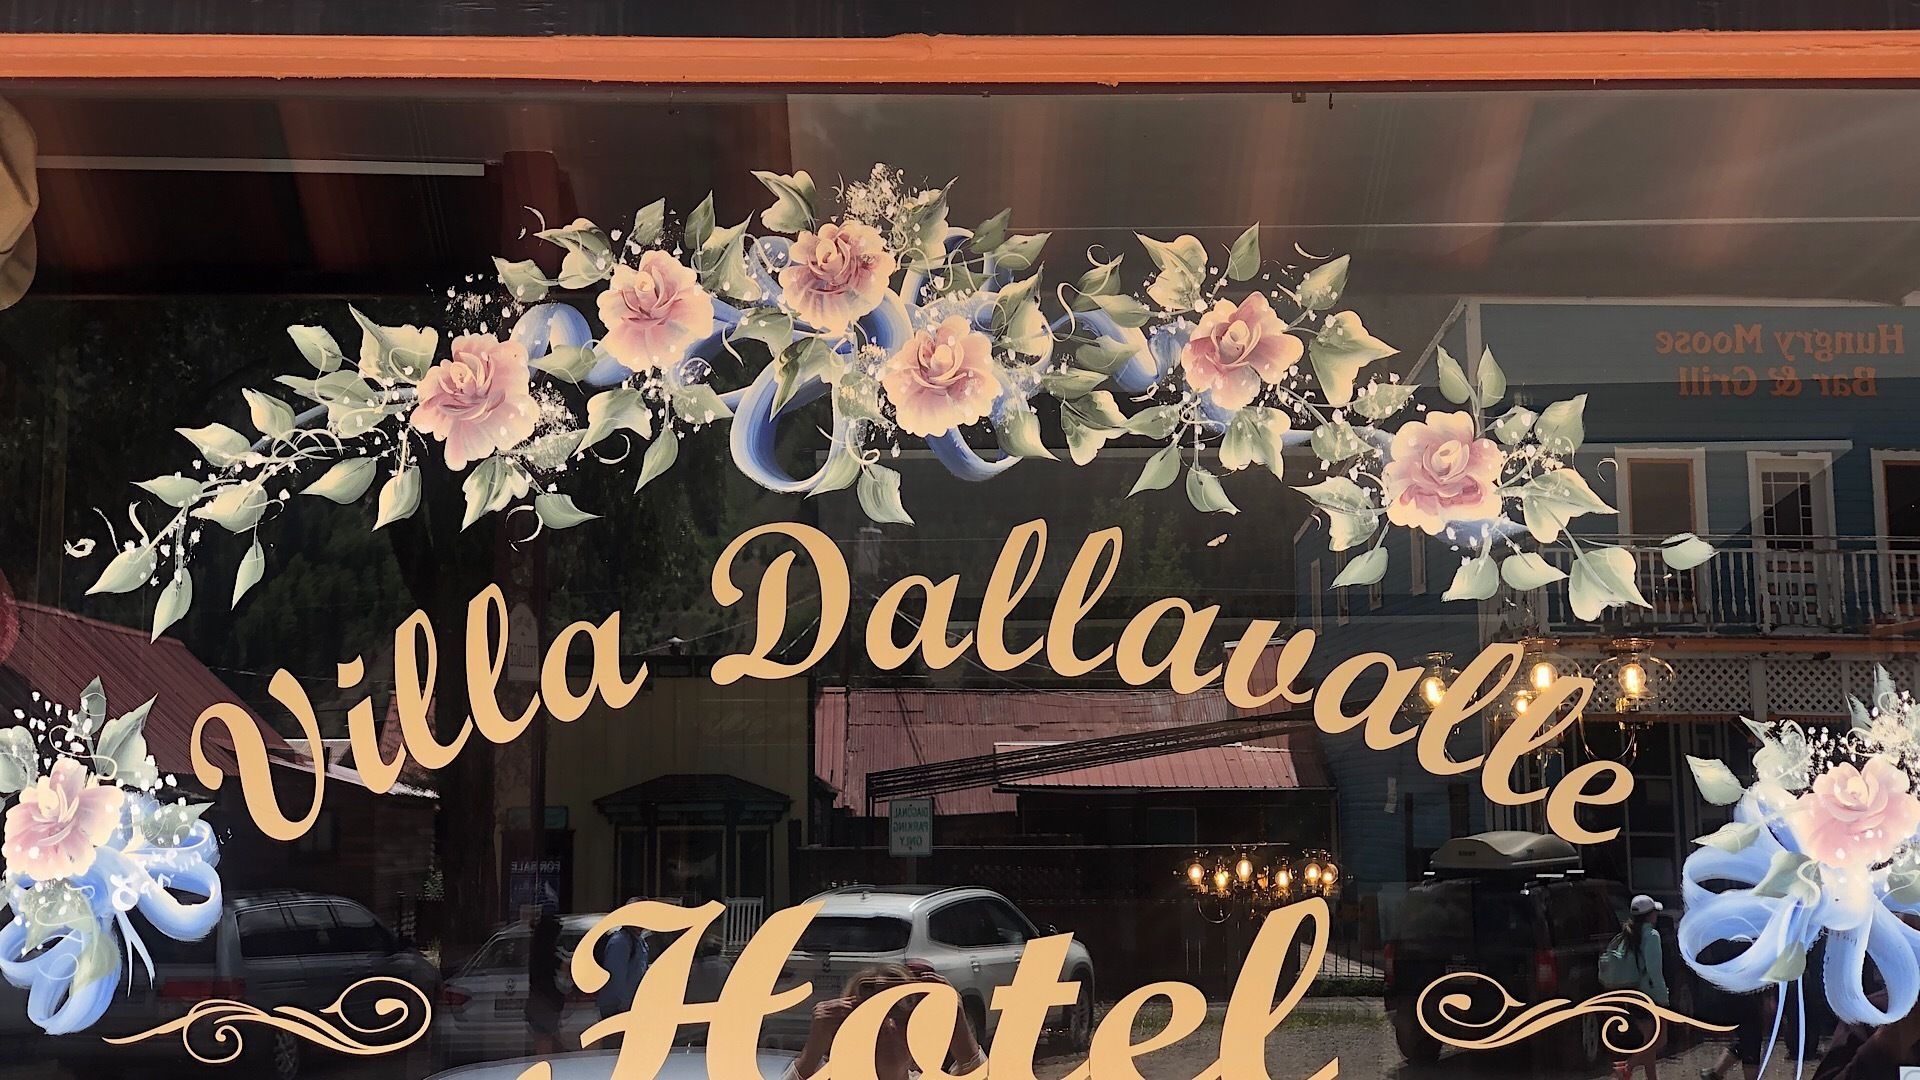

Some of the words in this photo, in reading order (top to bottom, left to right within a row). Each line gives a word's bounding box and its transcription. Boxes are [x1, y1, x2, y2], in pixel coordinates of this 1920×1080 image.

[190, 582, 648, 841] Villa
[711, 518, 1638, 845] Dallavalle
[516, 897, 1340, 1080] Hotel
